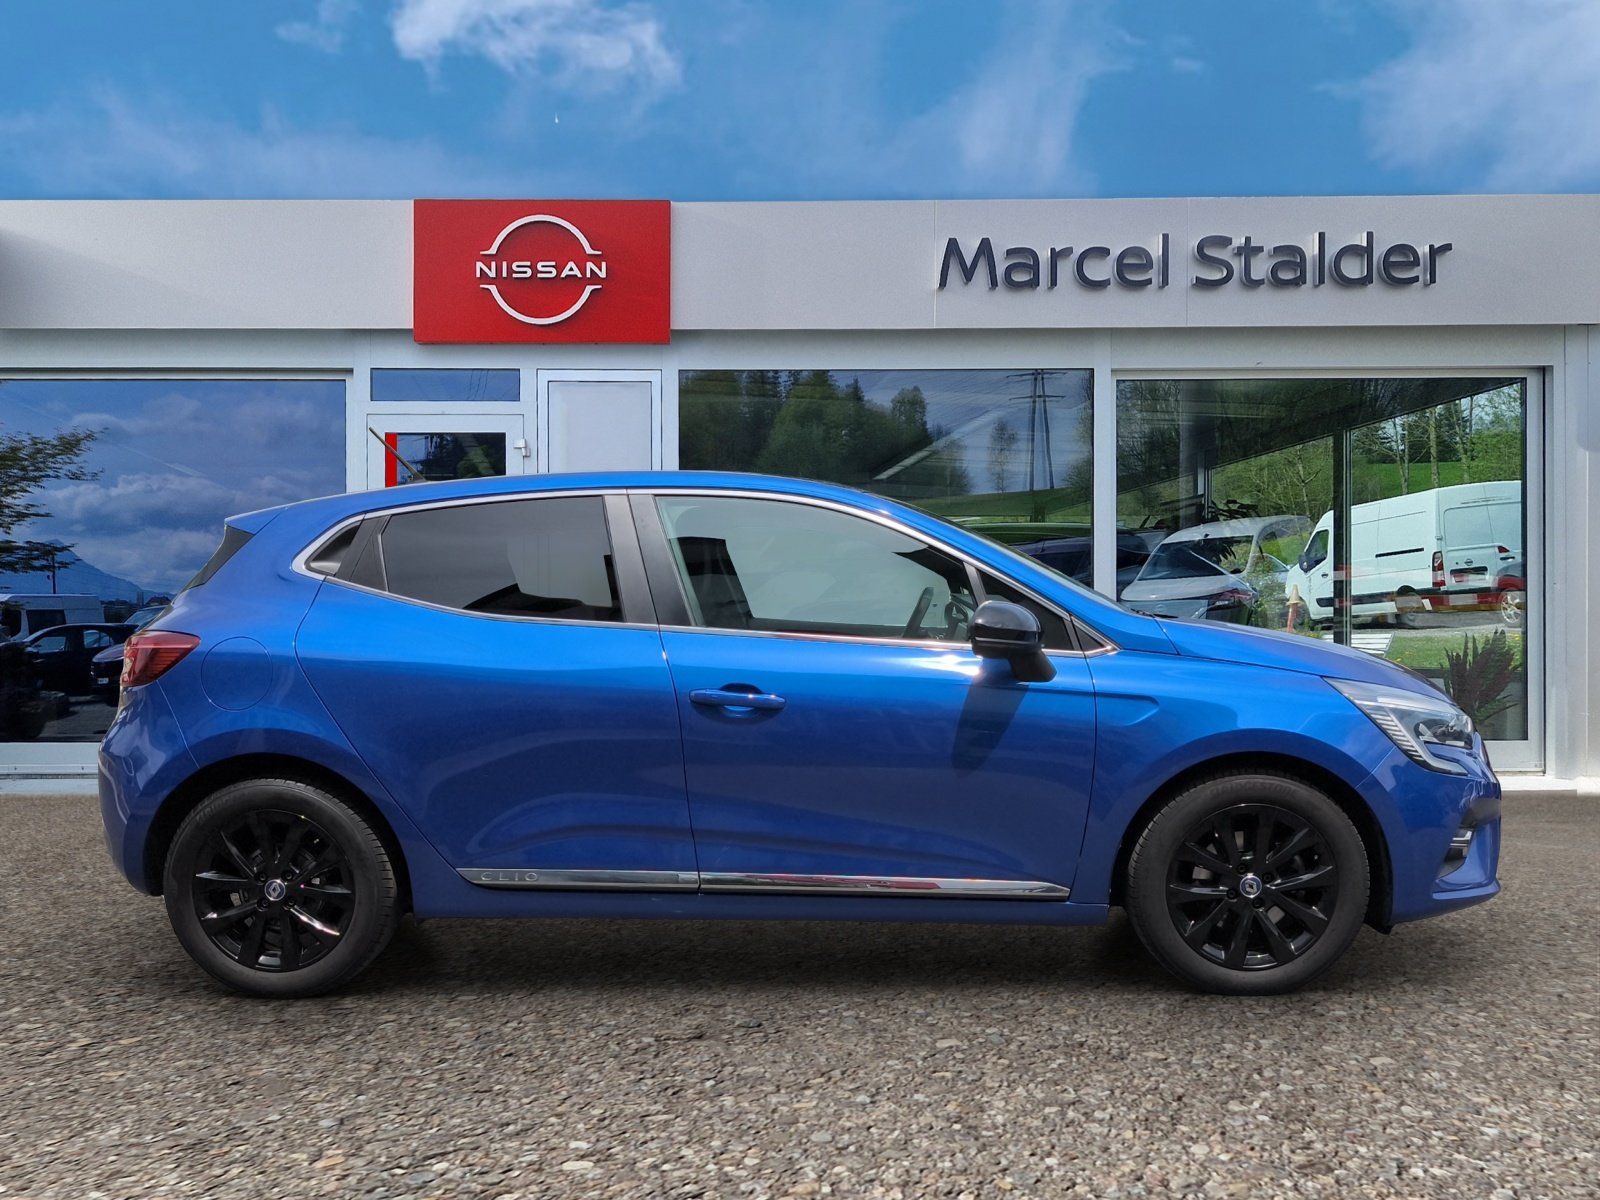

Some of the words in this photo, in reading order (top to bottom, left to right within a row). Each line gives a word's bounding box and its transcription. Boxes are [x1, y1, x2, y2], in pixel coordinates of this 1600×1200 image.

[938, 233, 1170, 289] Marcel
[1191, 231, 1453, 288] Stalder
[475, 261, 607, 278] NISSAN
[481, 871, 538, 881] CLIO
